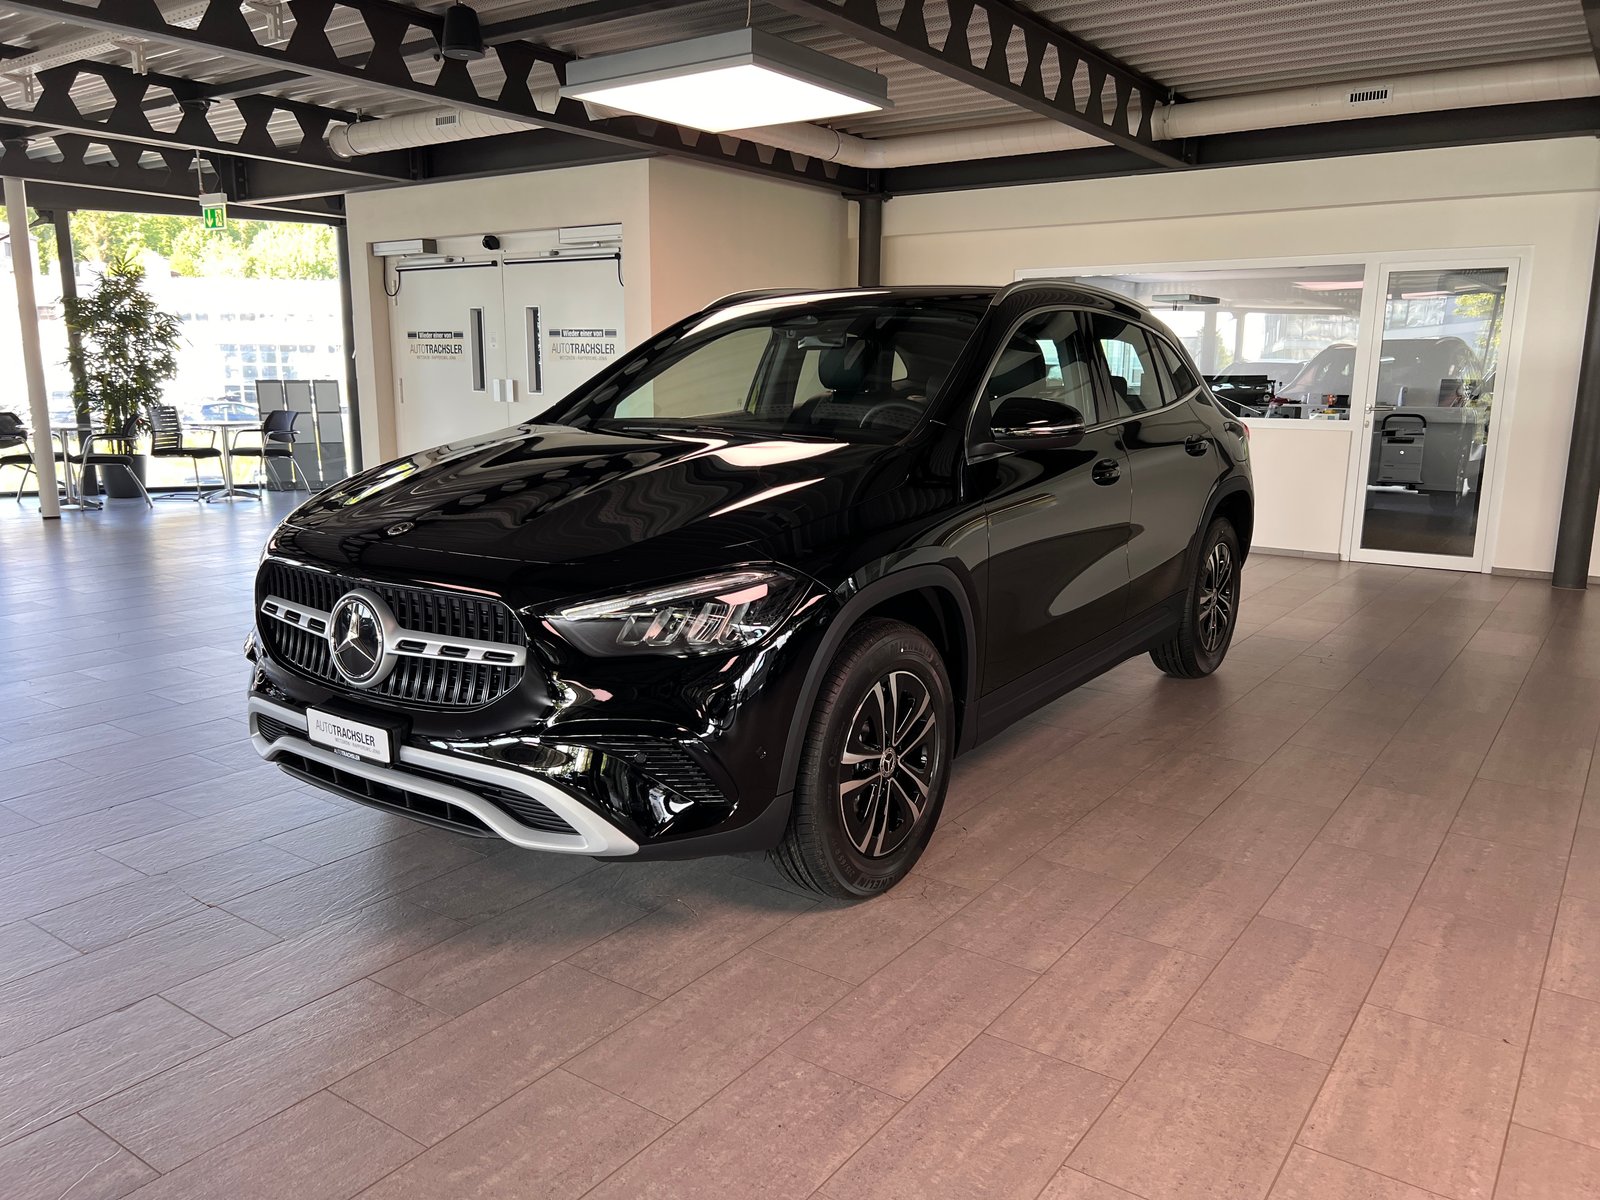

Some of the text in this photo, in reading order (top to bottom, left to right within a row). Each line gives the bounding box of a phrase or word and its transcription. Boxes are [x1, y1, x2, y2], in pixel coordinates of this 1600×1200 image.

[563, 329, 579, 337] Wieder
[580, 329, 592, 337] einer
[410, 343, 463, 354] AUTOTRACHSLER
[551, 342, 615, 354] AUTOTRACHSLER
[315, 719, 376, 747] AUTOTRACHSLER
